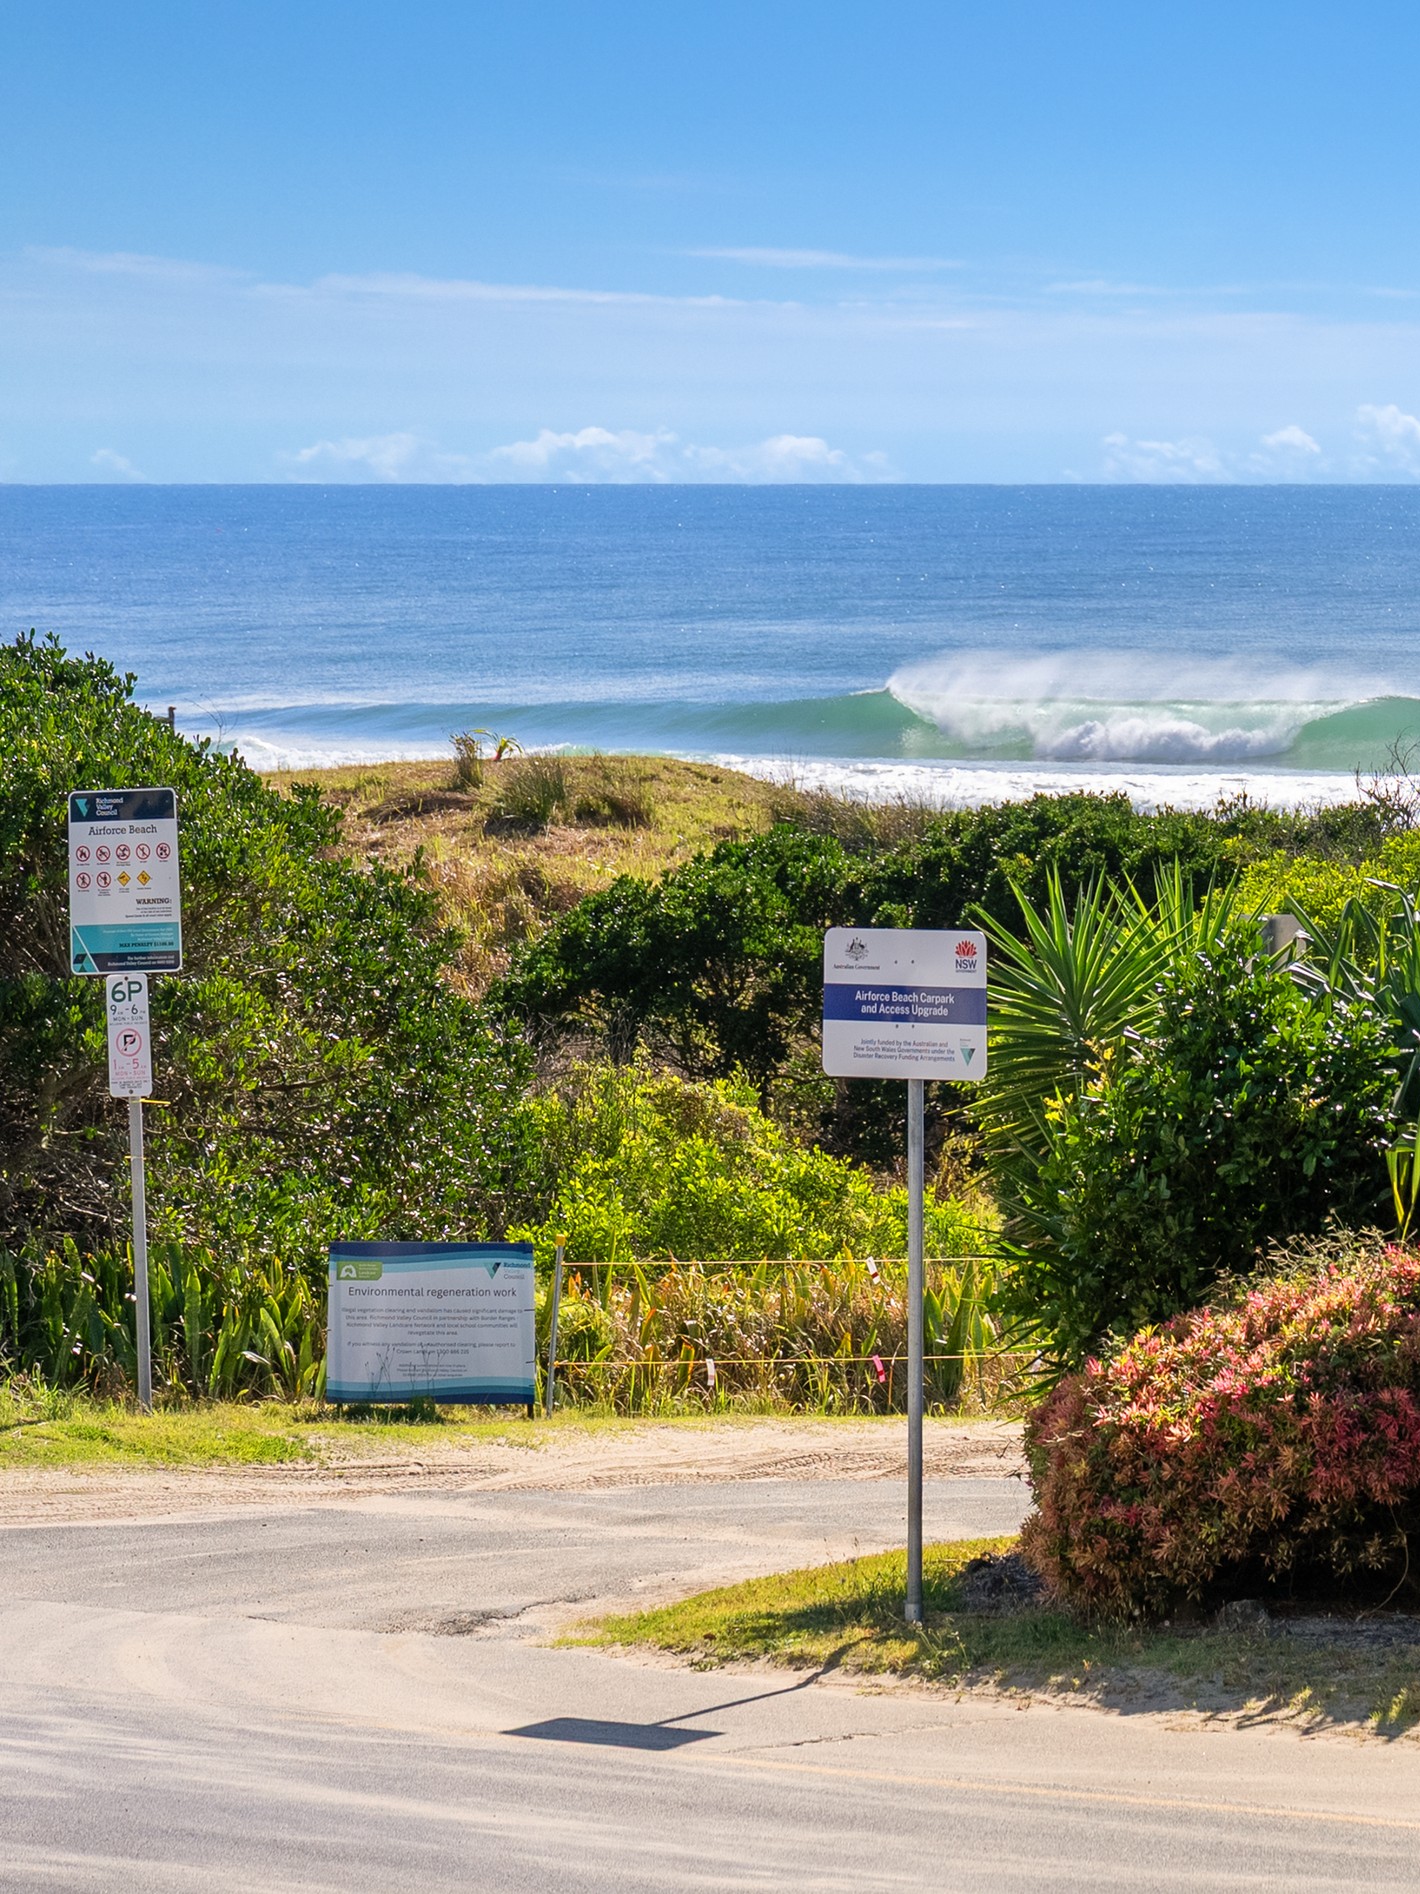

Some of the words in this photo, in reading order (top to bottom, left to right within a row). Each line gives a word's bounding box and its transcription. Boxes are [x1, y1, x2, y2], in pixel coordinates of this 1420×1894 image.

[88, 826, 126, 836] Airforce
[129, 825, 157, 834] Beach
[956, 959, 977, 969] NSW
[111, 981, 142, 1003] 6P
[855, 990, 890, 1001] Airforce
[892, 991, 918, 1002] Beach
[920, 993, 954, 1005] Carpark
[861, 1004, 877, 1013] and
[879, 1005, 909, 1014] Access
[912, 1006, 948, 1017] Upgrade
[348, 1287, 424, 1296] Environmental
[427, 1287, 490, 1299] regeneration
[494, 1287, 517, 1297] work
